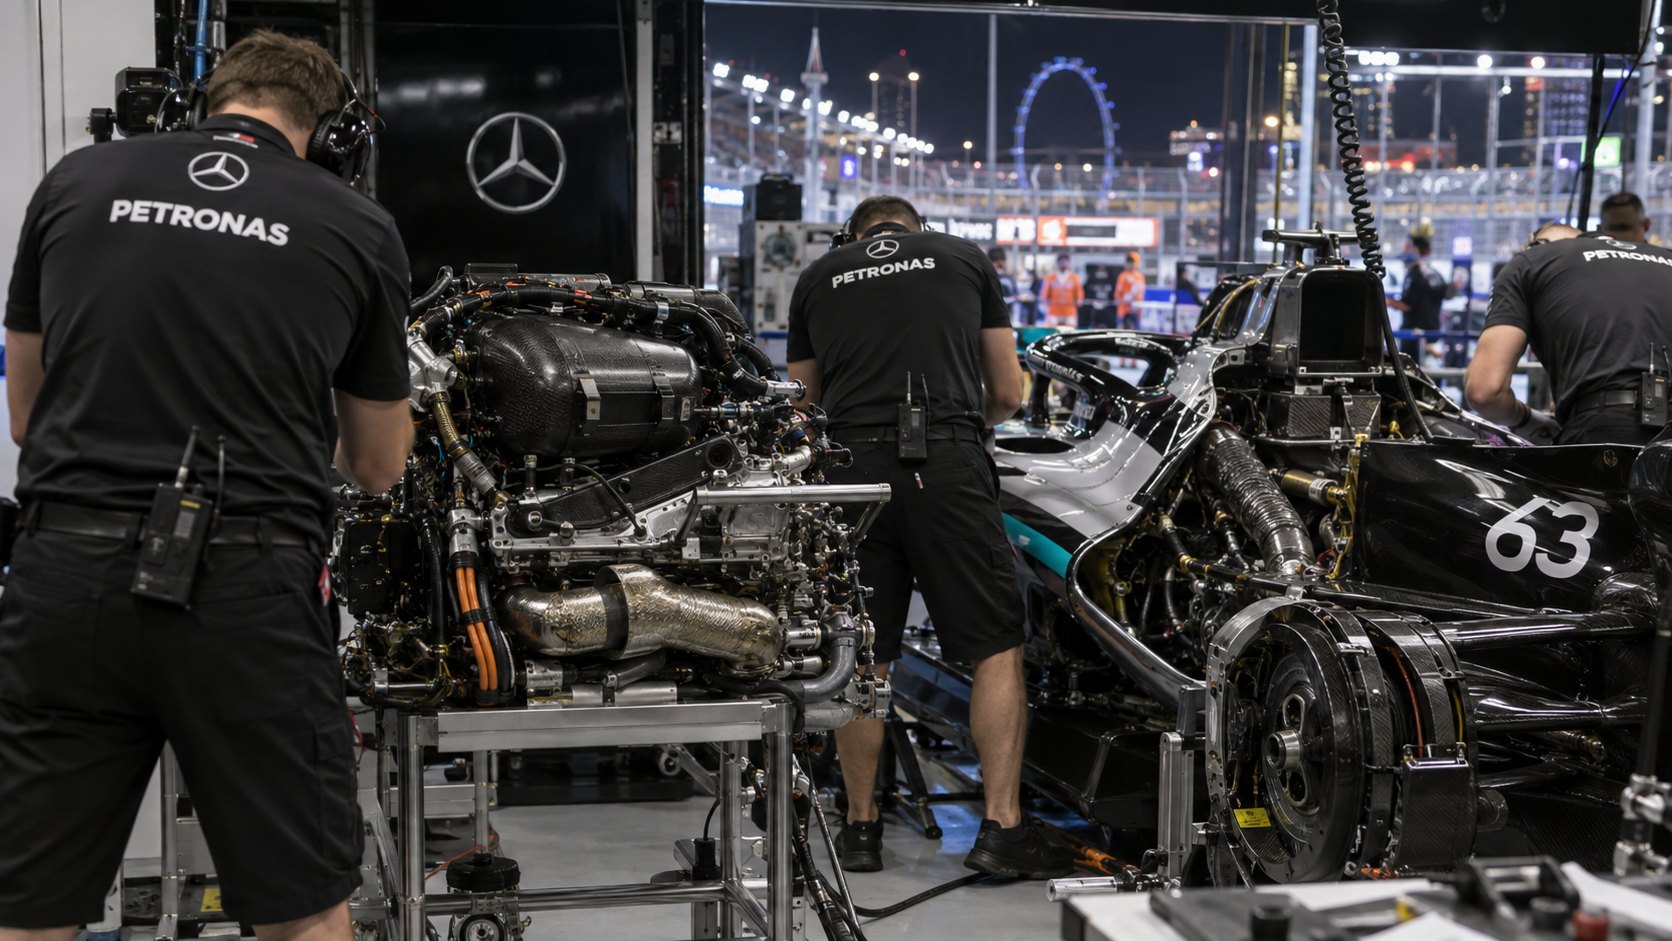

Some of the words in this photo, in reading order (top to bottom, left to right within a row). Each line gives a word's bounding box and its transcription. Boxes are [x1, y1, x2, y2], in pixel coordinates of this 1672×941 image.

[109, 199, 289, 246] PETRONAS
[831, 257, 935, 289] PETRONAS
[1485, 496, 1600, 579] 63
